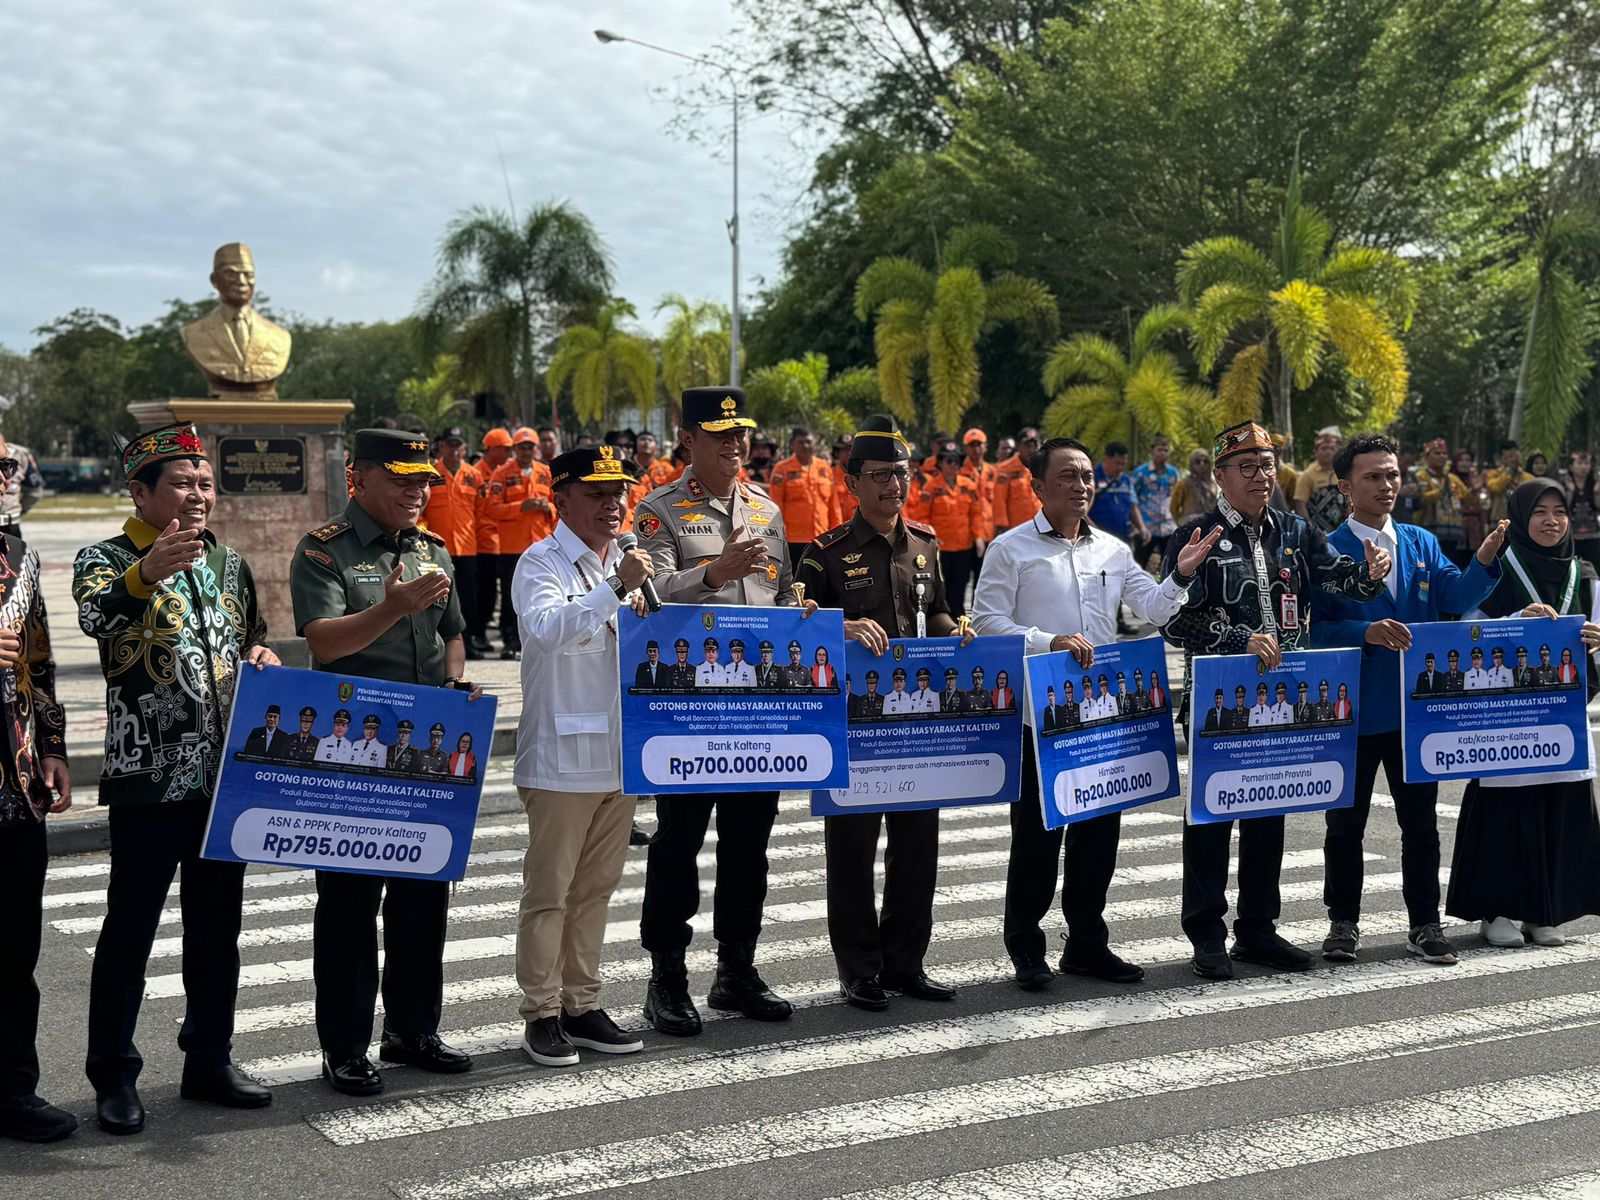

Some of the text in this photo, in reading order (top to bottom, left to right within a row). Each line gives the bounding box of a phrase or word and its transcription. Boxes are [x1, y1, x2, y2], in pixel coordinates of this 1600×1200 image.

[682, 525, 712, 534] IWAN
[357, 688, 390, 698] PEMERINTAH
[649, 701, 823, 710] GOTONG ROYONG MASYARAKAT KALTENG
[1427, 696, 1567, 712] GOTONG ROYONG MASYARAKAT KALTENG
[848, 723, 1000, 738] OTONG ROYONG MASYARAKAT KALTENG
[708, 740, 771, 752] Bank Kalteng
[1214, 732, 1341, 750] GOTONG ROYONG MASYARAKAT KALTENG
[1458, 731, 1539, 746] Kab/Kota se-Kalteng
[1436, 742, 1560, 770] Rp3.900.000.000
[670, 755, 808, 780] Rp700.000.000
[1098, 764, 1125, 777] Himbara
[1241, 768, 1312, 782] Pemerintah Provinsi
[255, 771, 454, 800] GOTONG ROYONG MASYARAKAT KALTENG
[280, 788, 302, 797] Peduli
[854, 782, 868, 794] 129
[876, 782, 892, 793] 521
[898, 781, 915, 792] 600
[1074, 772, 1152, 808] Rp20.000.000
[1218, 780, 1332, 810] Rp3.000.000.000
[268, 816, 427, 843] ASN & PPPK Pemprov Kalteng
[262, 832, 422, 864] Rp795.000.000
